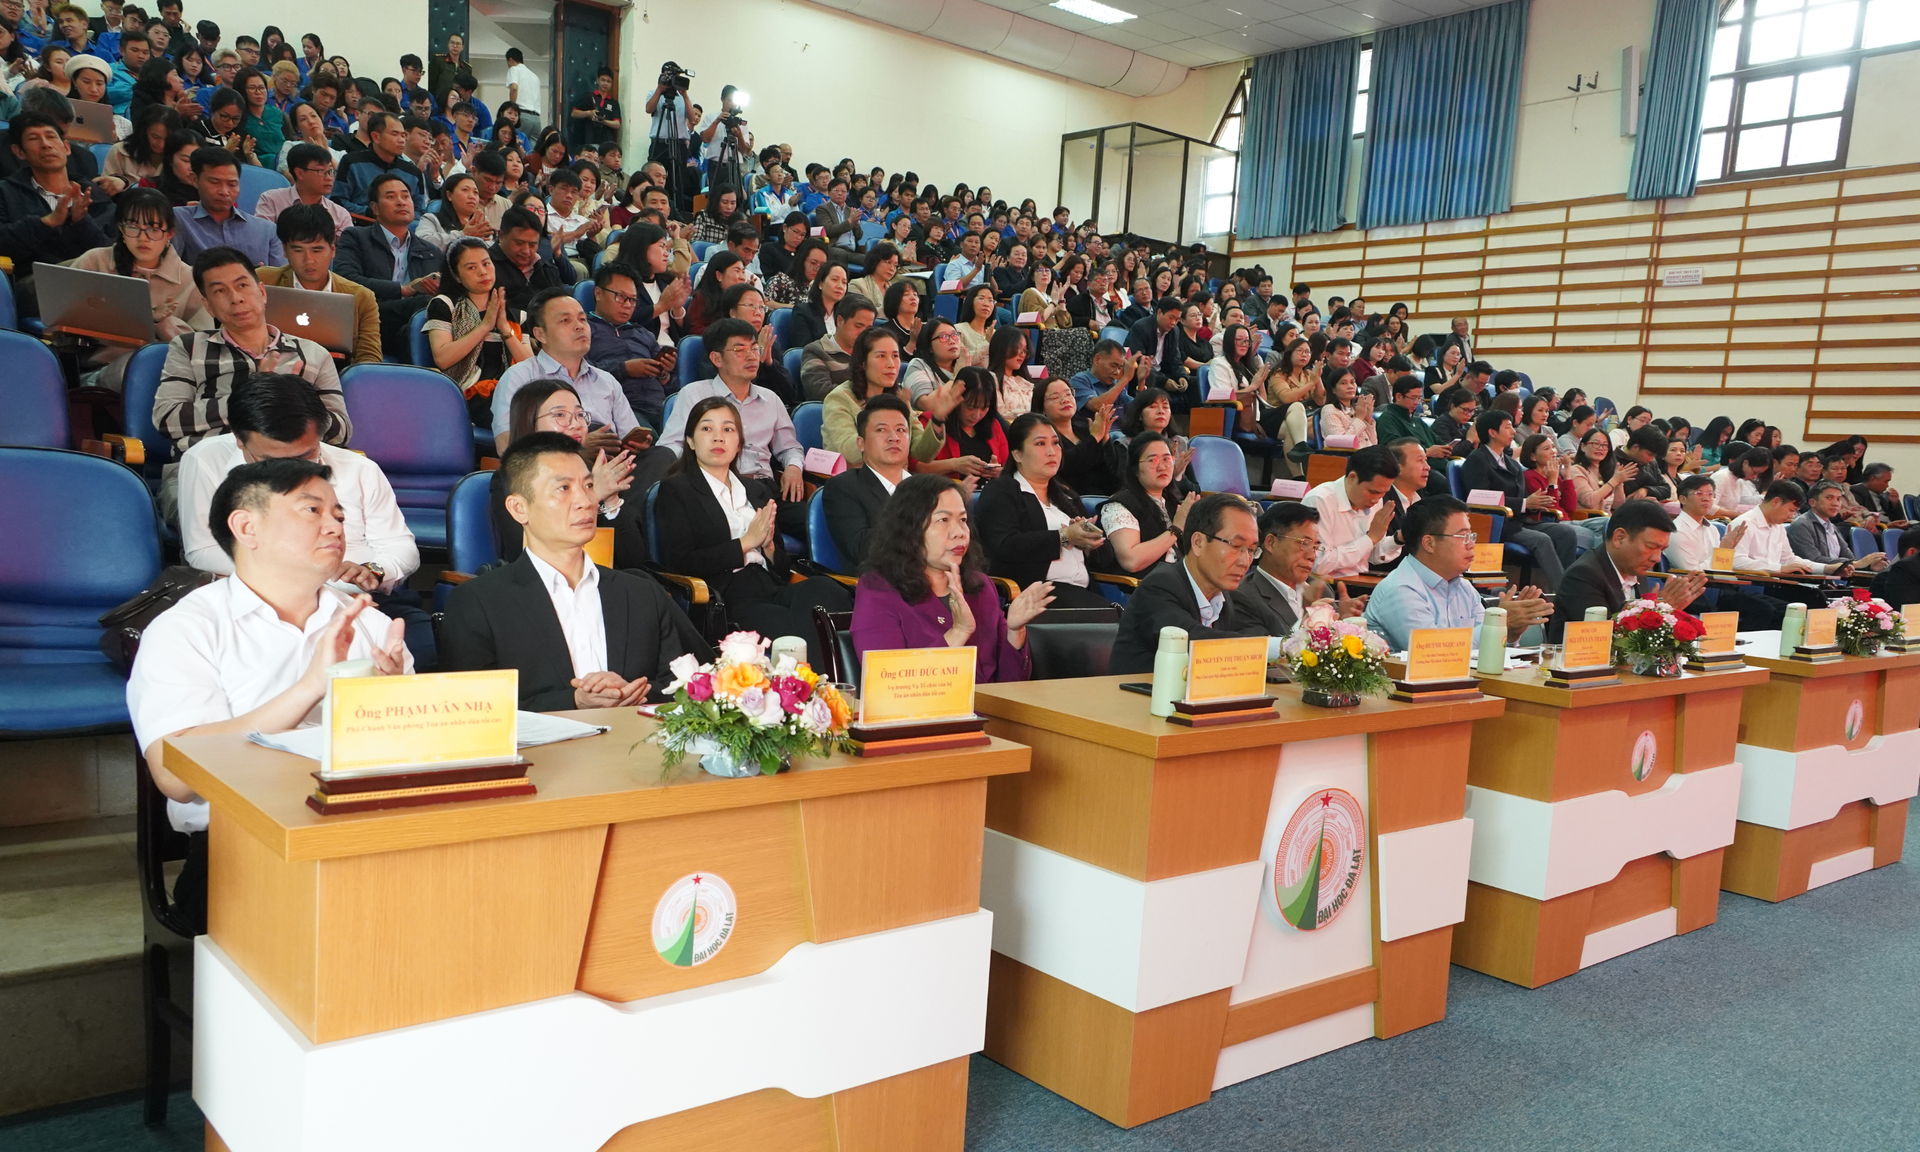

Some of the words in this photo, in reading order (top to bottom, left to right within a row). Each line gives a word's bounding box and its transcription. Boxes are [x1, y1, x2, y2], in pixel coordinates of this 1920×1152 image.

[880, 668, 897, 680] Ông
[898, 668, 917, 678] CHU
[920, 666, 938, 677] ĐỨC
[940, 666, 958, 676] ANH
[355, 705, 382, 720] Ông
[386, 704, 428, 718] PHẠM
[432, 701, 460, 714] VĂN
[464, 701, 493, 713] NHẠ
[1332, 888, 1348, 913] HỌC
